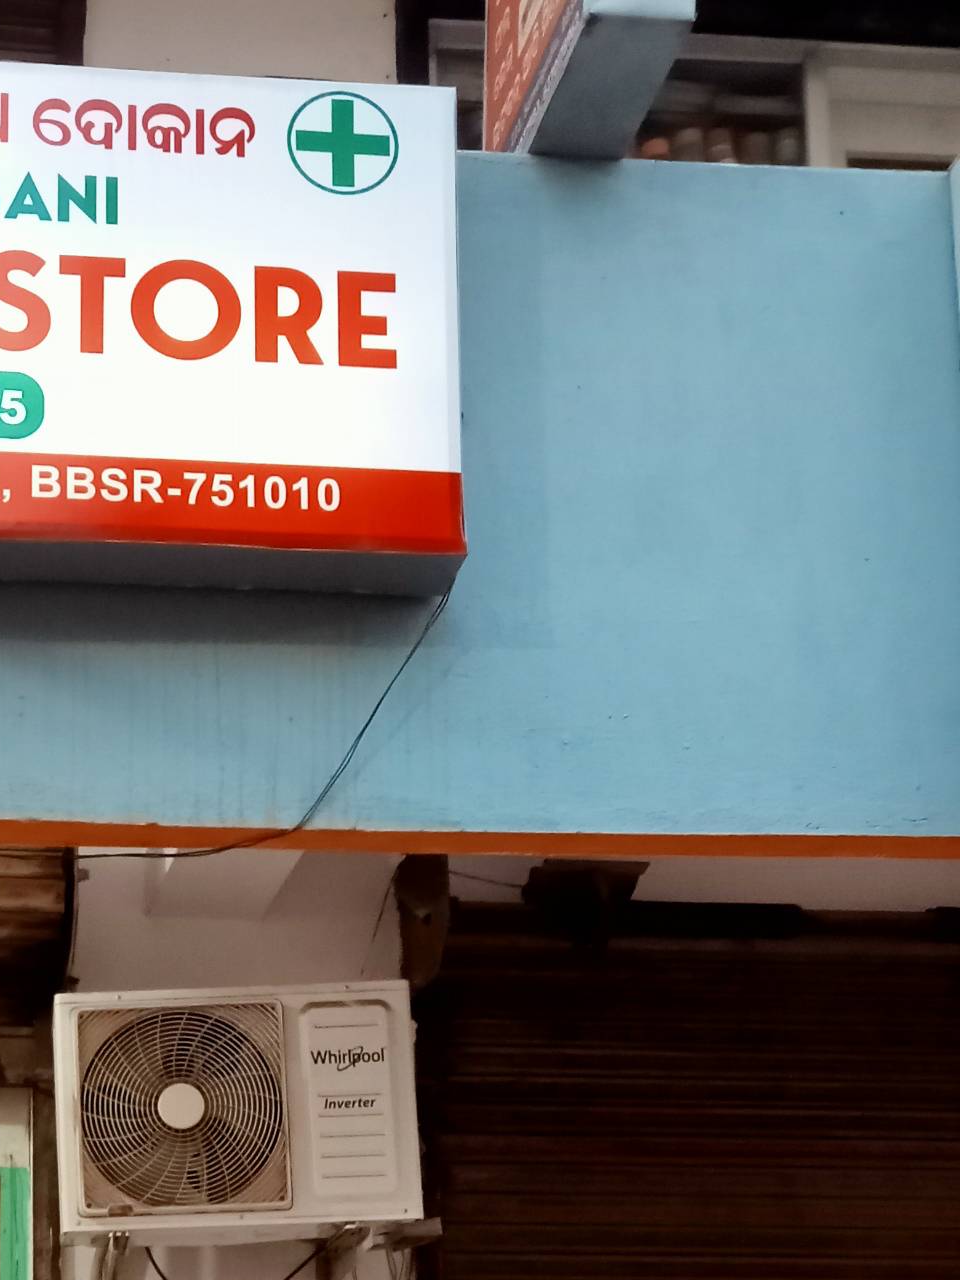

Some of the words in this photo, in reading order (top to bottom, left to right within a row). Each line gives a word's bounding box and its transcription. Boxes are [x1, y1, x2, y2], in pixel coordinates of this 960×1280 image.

[32, 98, 255, 157] ଦୋକାନ
[30, 465, 340, 512] BBSR-751010
[311, 1046, 385, 1071] Whirlpool
[324, 1098, 376, 1109] Inverter
